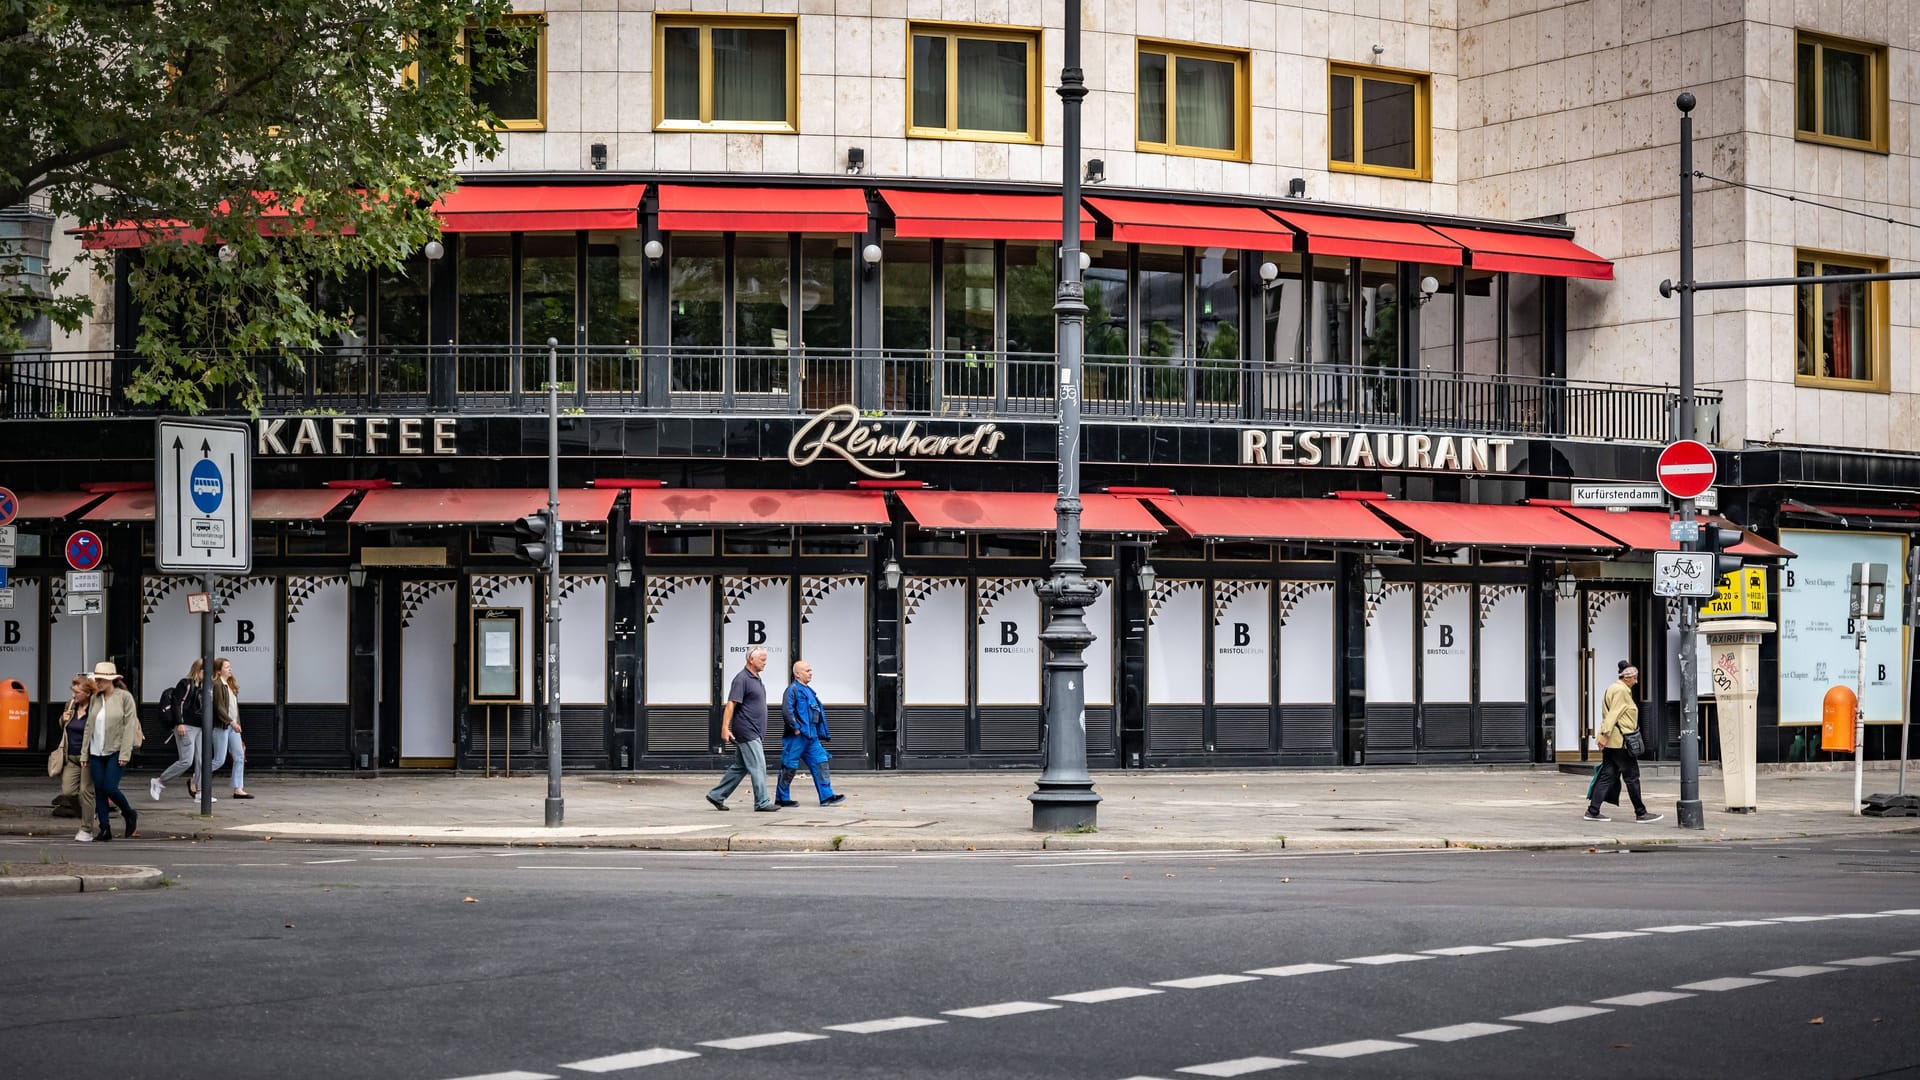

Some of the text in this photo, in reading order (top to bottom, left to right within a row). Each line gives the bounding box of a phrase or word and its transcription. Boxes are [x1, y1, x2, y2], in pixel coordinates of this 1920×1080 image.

[258, 418, 458, 455] KAFFEE
[788, 404, 1006, 479] Reinhard's
[1242, 429, 1514, 472] RESTAURANT
[1577, 488, 1659, 500] Kurfürstendamm
[1786, 570, 1795, 587] B
[1711, 601, 1732, 612] TAXI
[4, 620, 21, 645] B
[236, 619, 256, 645] B
[747, 620, 767, 645] B
[1000, 621, 1019, 646] B
[1233, 622, 1251, 647] B
[1439, 624, 1454, 648] B
[1707, 633, 1744, 644] TAXIRUF
[1847, 618, 1856, 635] B
[1878, 664, 1886, 681] B
